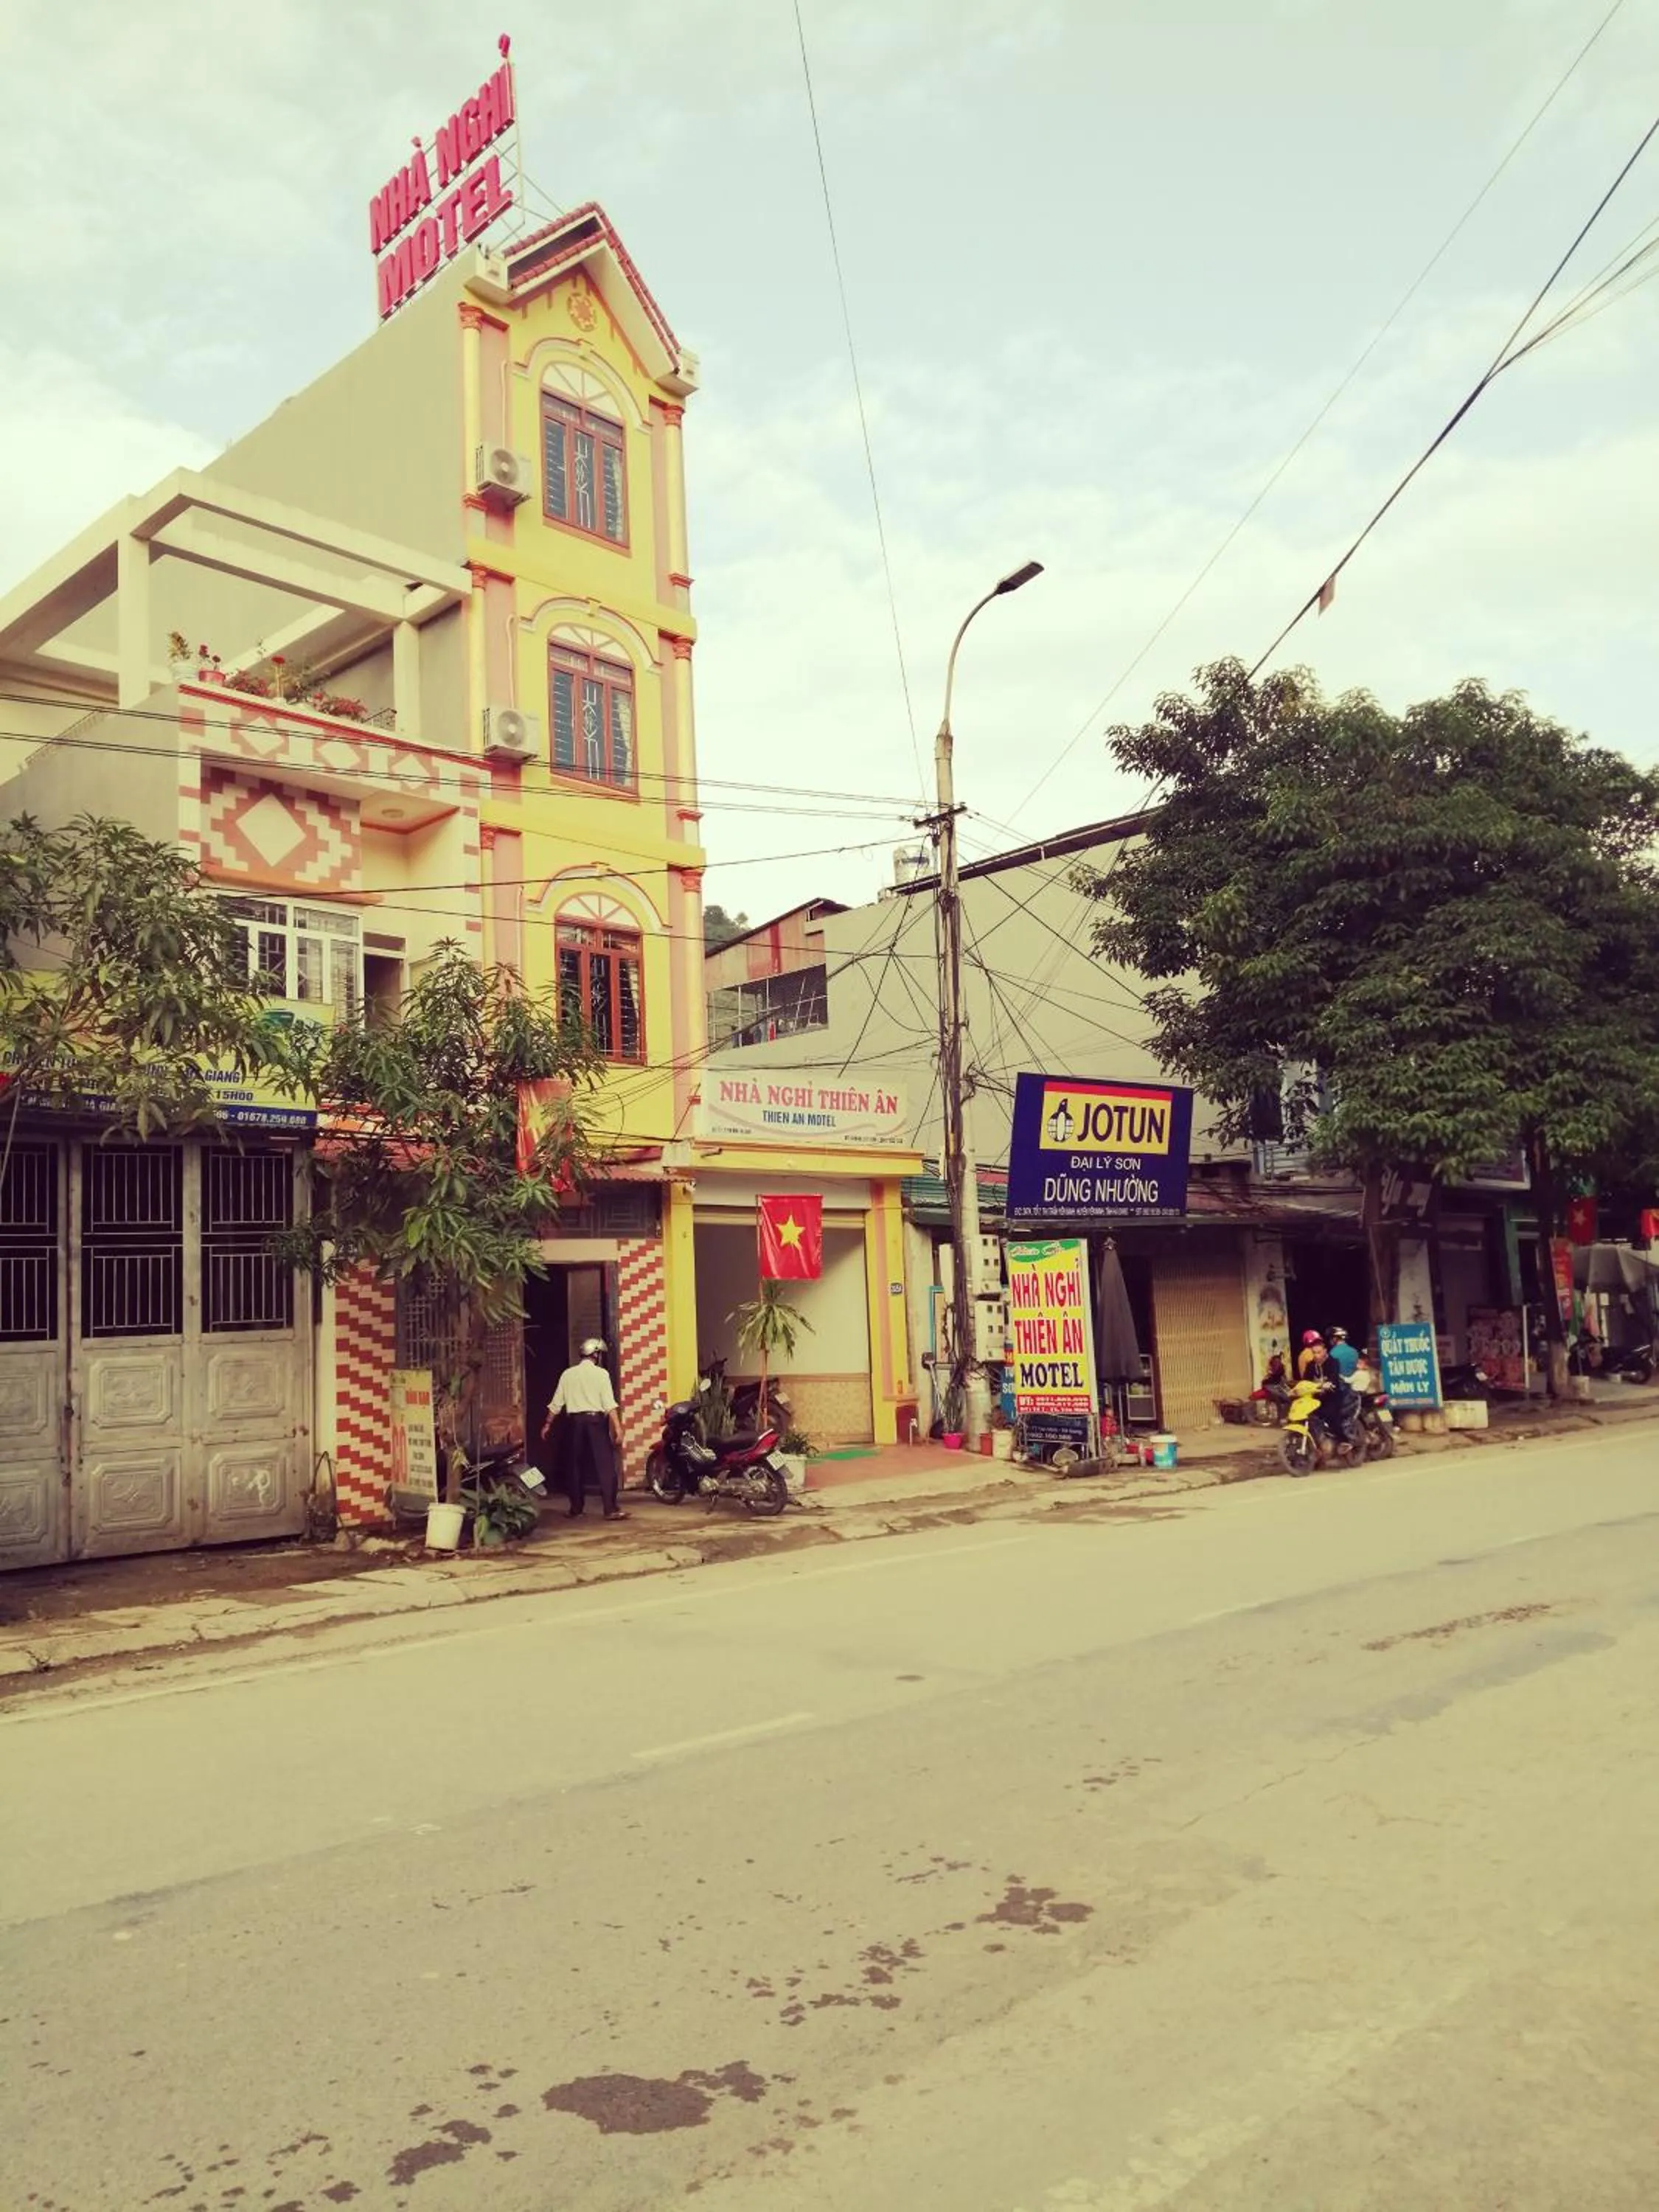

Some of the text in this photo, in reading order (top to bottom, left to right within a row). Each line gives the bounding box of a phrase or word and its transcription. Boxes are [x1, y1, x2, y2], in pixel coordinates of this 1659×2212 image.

[369, 33, 515, 256] NHÀ NGHỈ
[377, 154, 514, 320] MOTEL
[204, 1070, 242, 1083] GIANG
[719, 1077, 899, 1115] NHÀ NGHỈ THIÊN ÂN
[762, 1110, 836, 1127] THIEN AN MOTEL
[1077, 1102, 1166, 1144] JOTUN
[1071, 1155, 1141, 1172] ĐẠI LÝ SƠN
[1044, 1173, 1159, 1203] DŨNG NHƯỜNG
[1011, 1257, 1082, 1309] NHÀ NGHỈ
[1014, 1311, 1084, 1354] THIÊN ÂN
[1020, 1362, 1084, 1388] MOTEL
